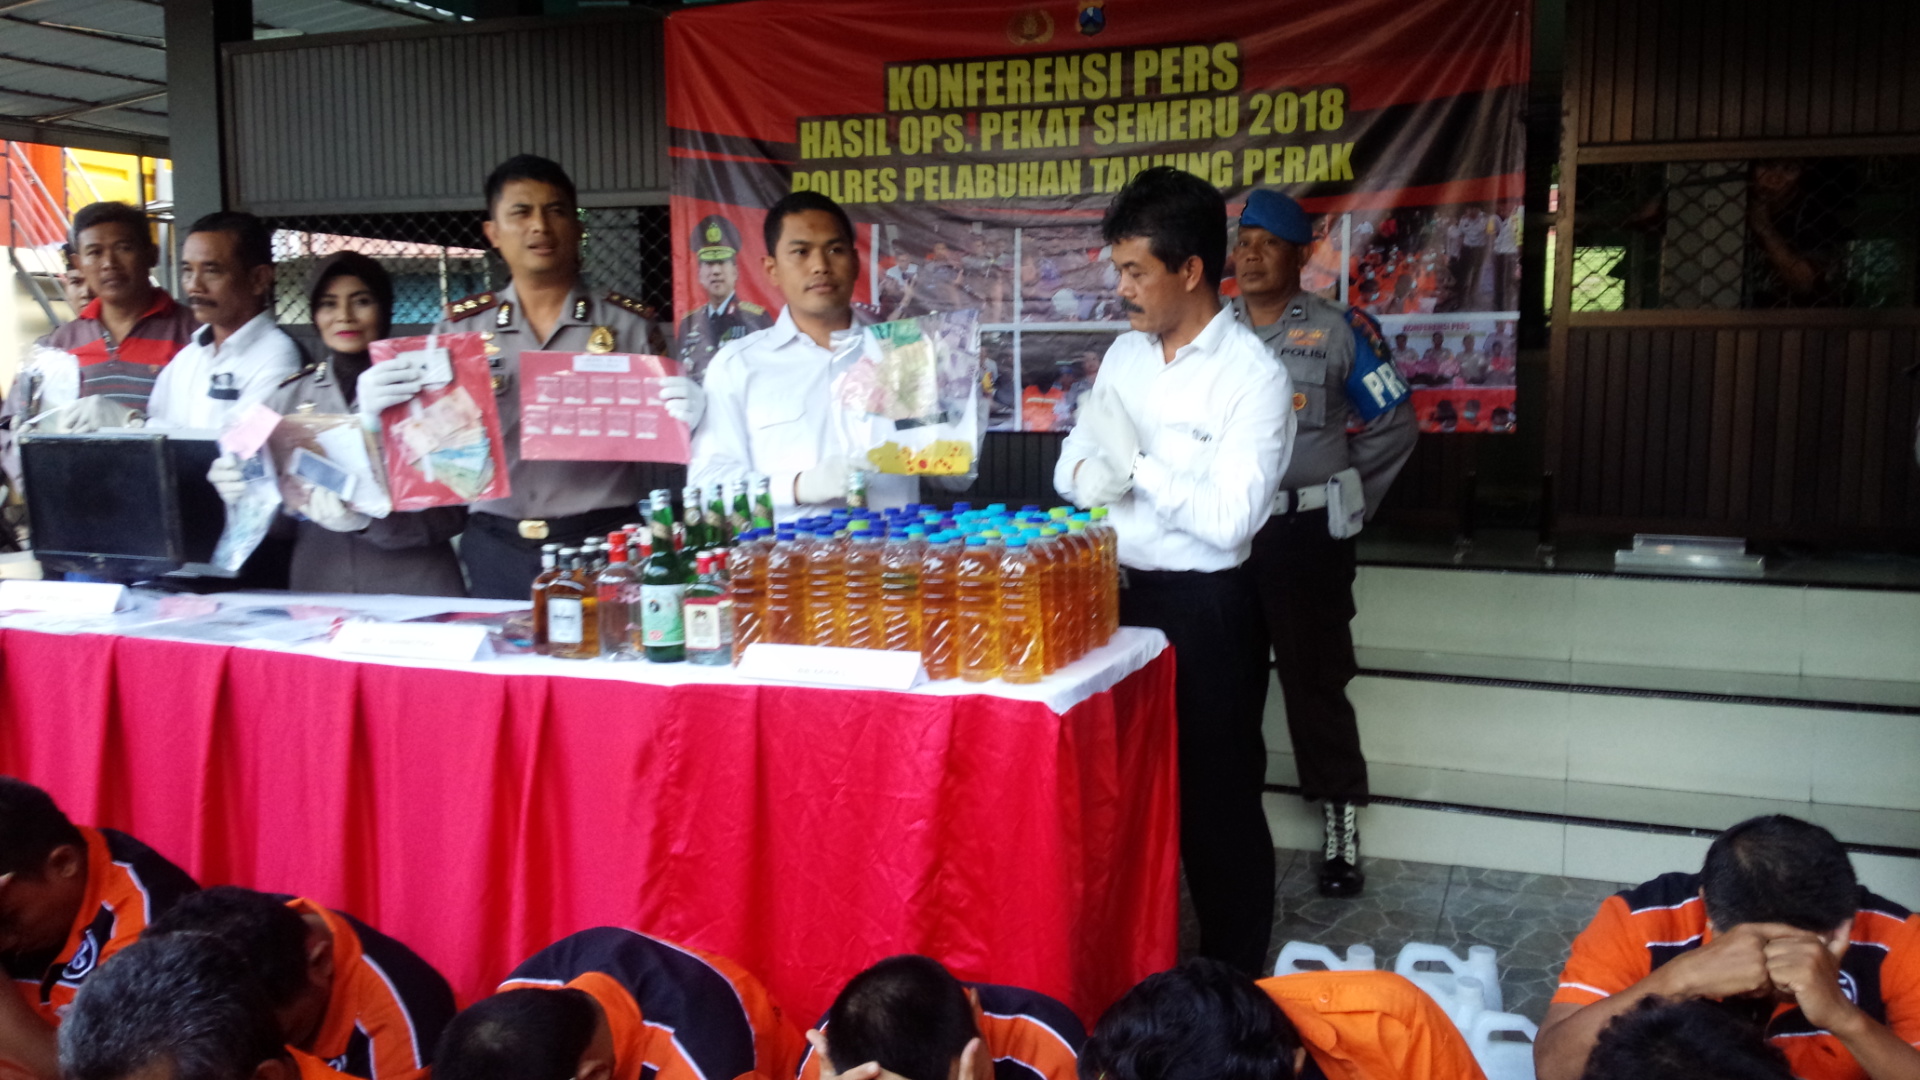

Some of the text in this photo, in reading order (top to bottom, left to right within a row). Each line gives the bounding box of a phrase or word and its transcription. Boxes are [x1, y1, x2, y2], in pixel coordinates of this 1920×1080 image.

[888, 42, 1238, 111] KONFERENSI PERS
[801, 88, 1344, 159] HASIL OPS. PEKAT SEMERU 2018
[791, 167, 898, 204] POLRES
[905, 159, 1080, 201] PELABUHAN
[1243, 142, 1354, 185] PERAK
[1281, 348, 1327, 359] POLISI
